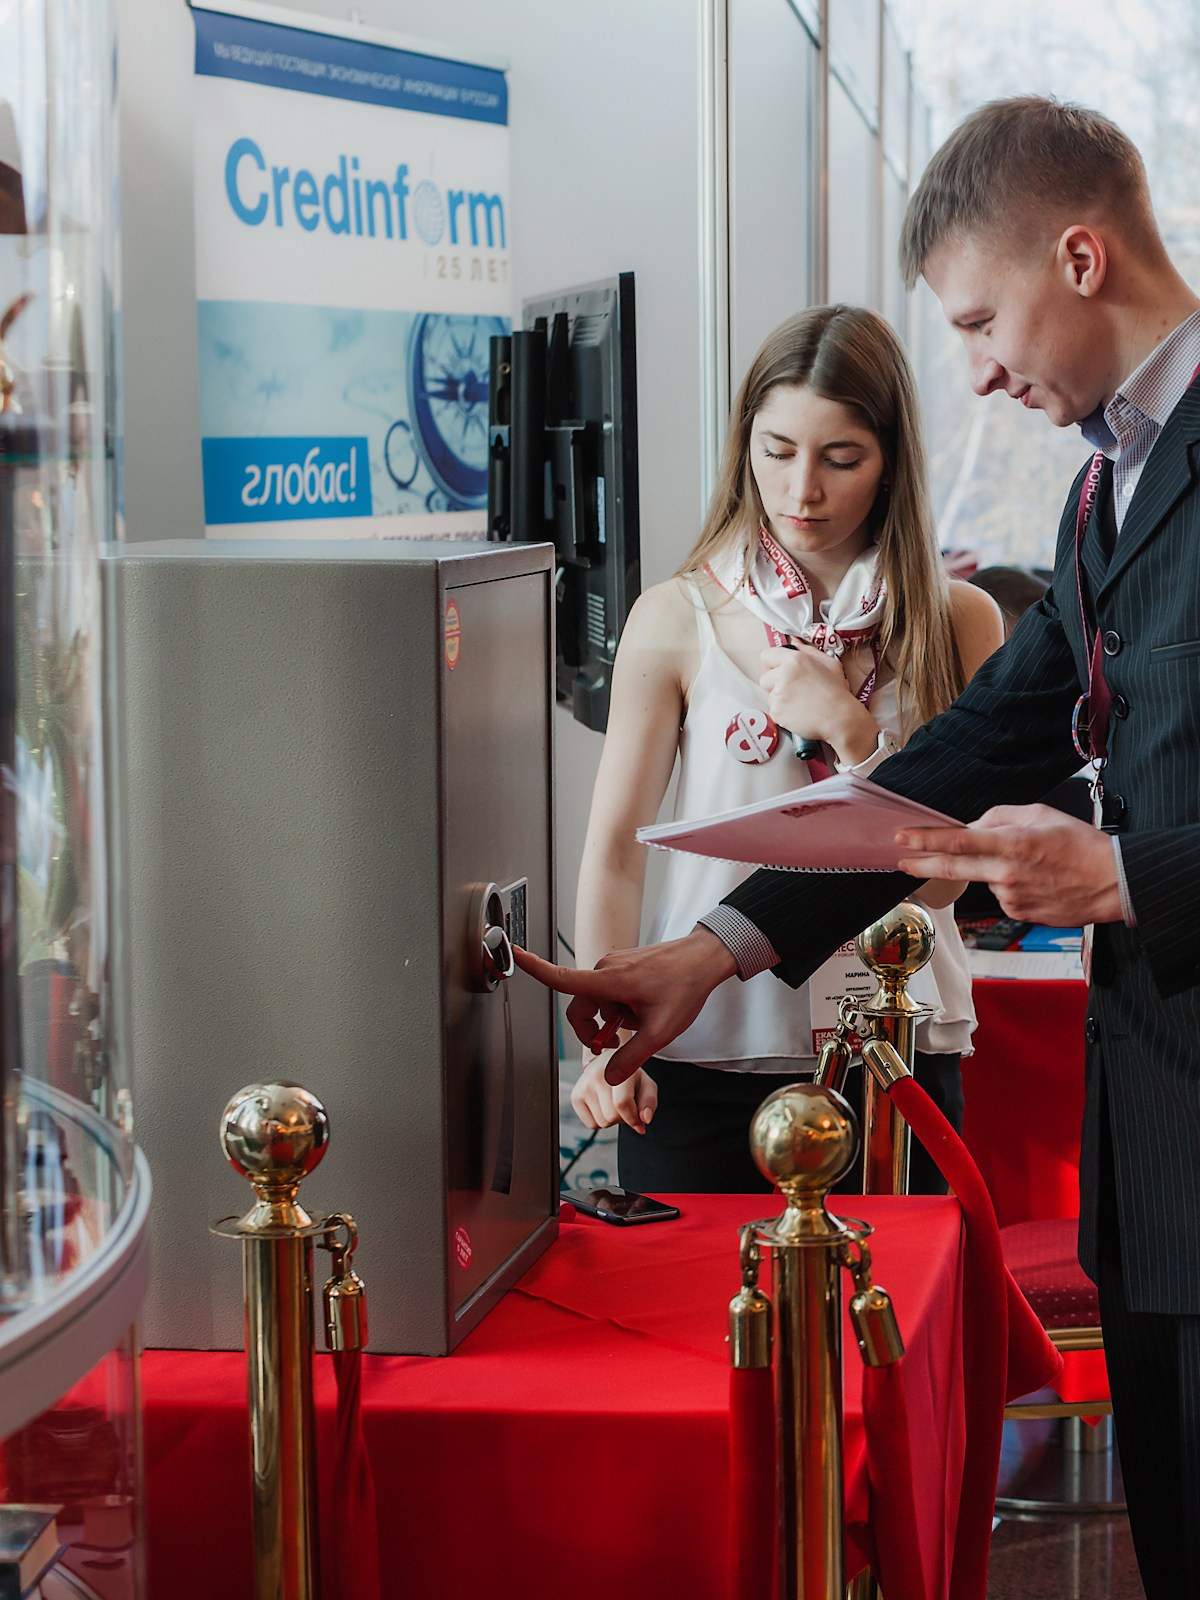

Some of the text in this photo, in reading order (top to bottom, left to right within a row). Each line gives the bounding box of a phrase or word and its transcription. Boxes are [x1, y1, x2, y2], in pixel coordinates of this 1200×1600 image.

[225, 137, 506, 249] Credinform
[437, 255, 462, 279] 25
[241, 446, 357, 507] глобас!
[761, 531, 805, 592] БЕЗОПАСНОС
[845, 971, 870, 979] МАРИНА
